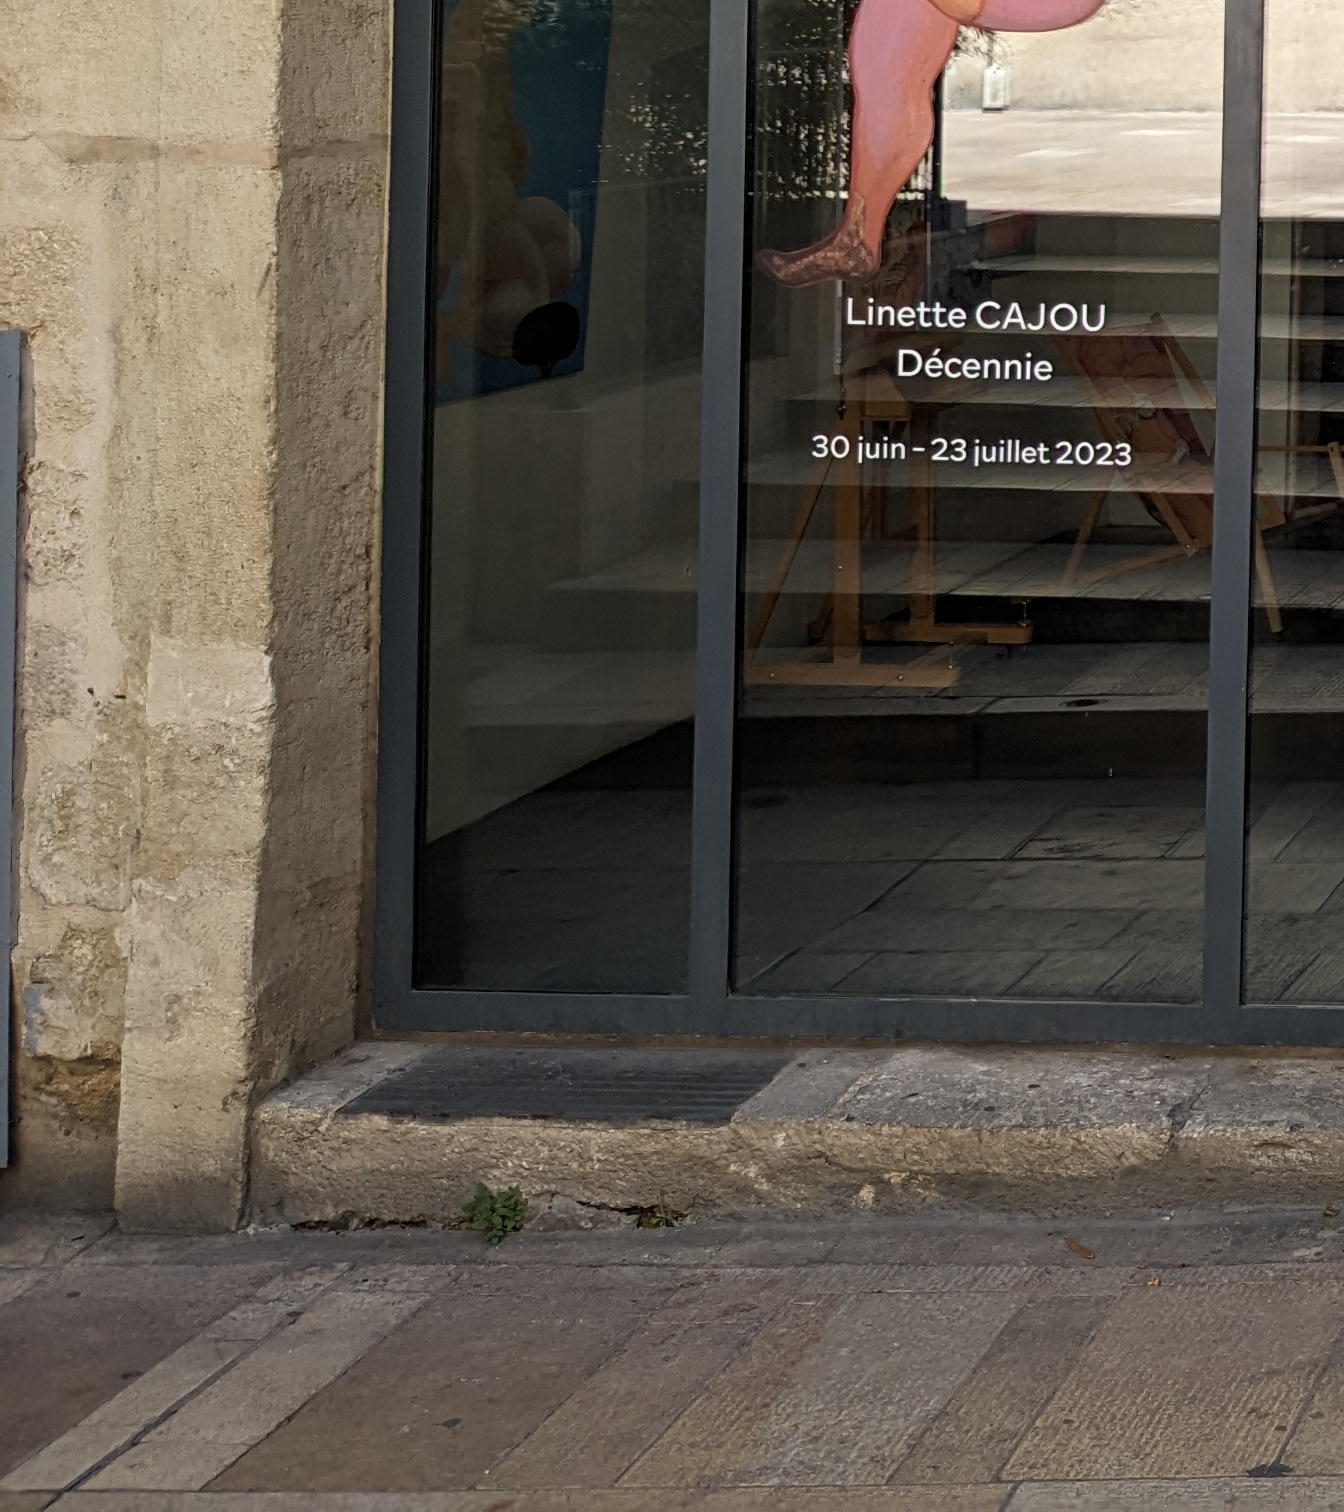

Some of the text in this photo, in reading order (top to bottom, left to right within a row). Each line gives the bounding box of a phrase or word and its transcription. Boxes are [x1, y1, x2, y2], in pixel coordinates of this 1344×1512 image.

[846, 297, 1106, 332] Linette CAJOU
[898, 348, 1053, 381] Décennie
[812, 435, 850, 459] 30
[857, 436, 906, 463] juin
[931, 438, 967, 462] 23
[973, 439, 1050, 467] juillet
[1055, 442, 1132, 467] 2023
